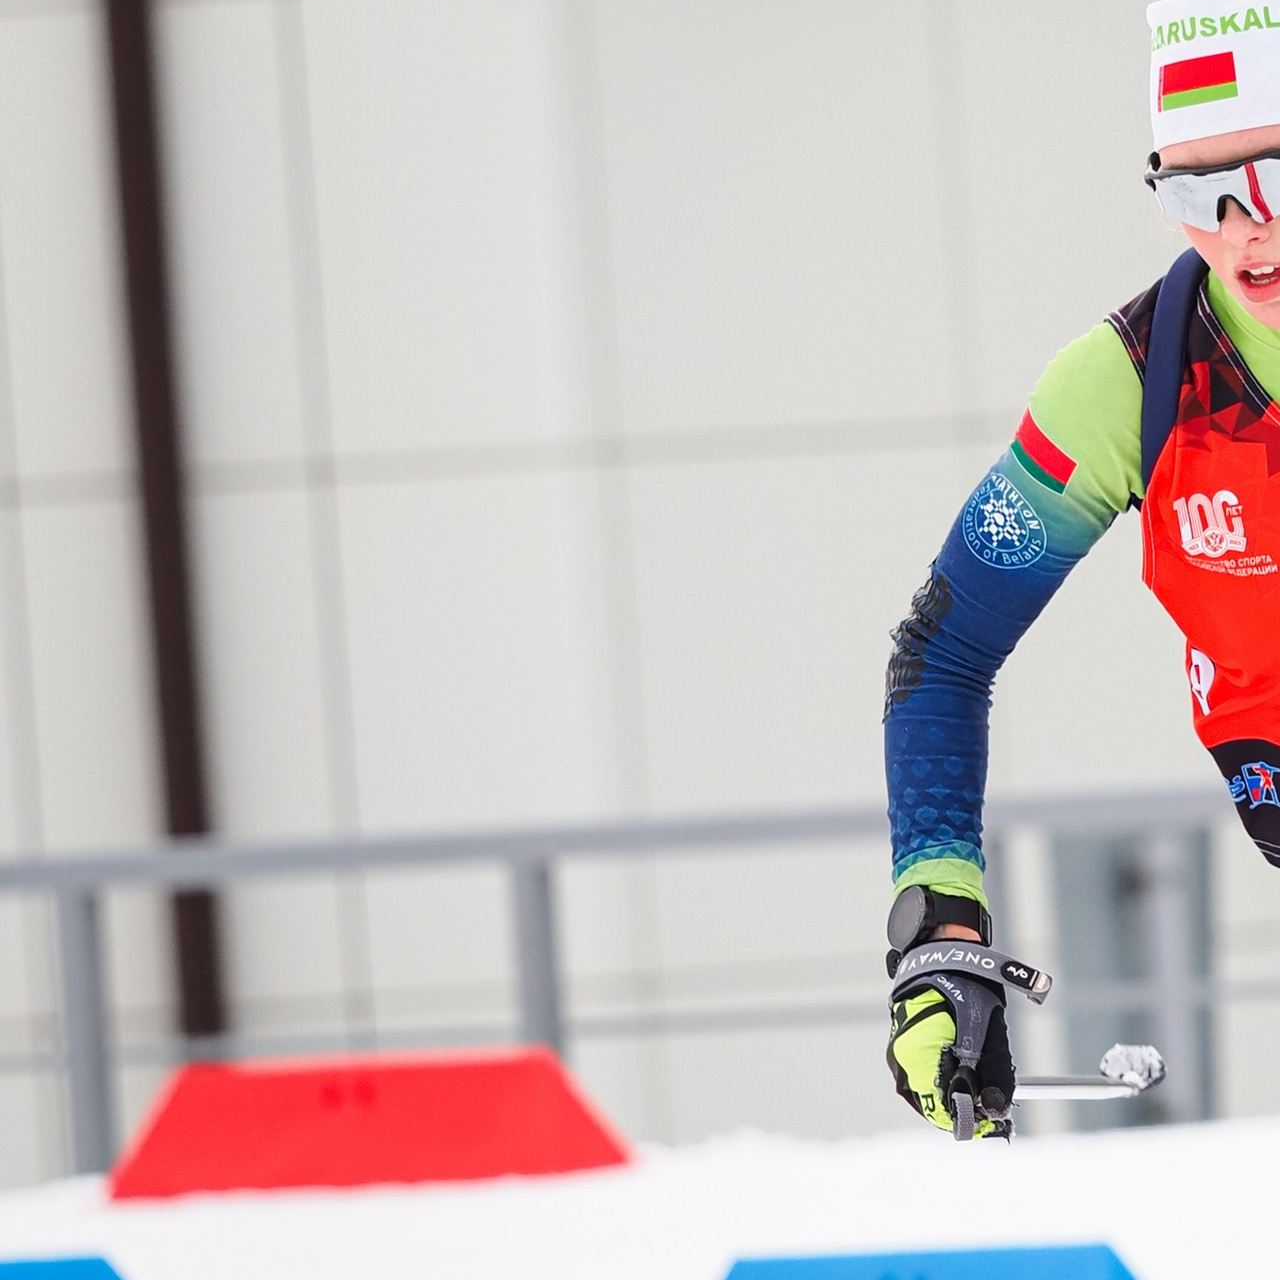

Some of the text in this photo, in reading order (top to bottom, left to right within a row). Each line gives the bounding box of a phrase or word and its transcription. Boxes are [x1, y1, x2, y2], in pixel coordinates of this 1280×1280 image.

[1226, 505, 1243, 516] ЛЕТ
[983, 549, 998, 562] of
[1238, 555, 1272, 567] СПОРТА
[908, 948, 996, 970] ONE/WAY
